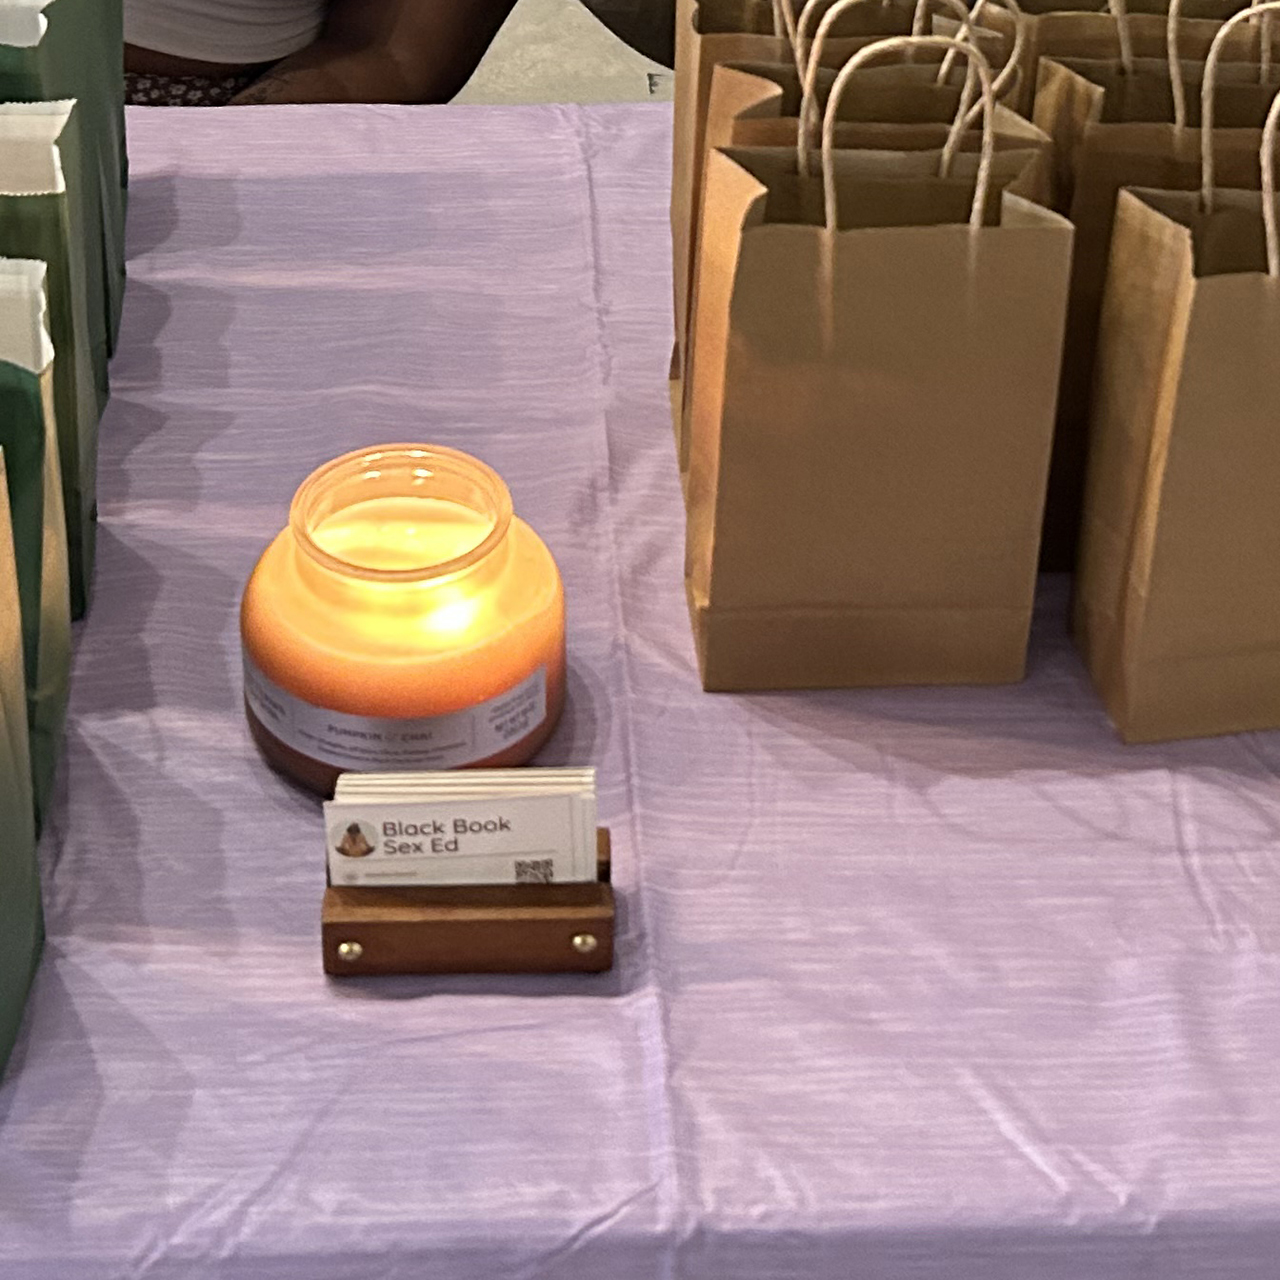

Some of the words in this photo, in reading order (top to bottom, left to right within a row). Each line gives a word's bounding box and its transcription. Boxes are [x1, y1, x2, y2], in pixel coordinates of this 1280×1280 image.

[383, 819, 446, 837] Black
[453, 817, 511, 834] Book
[384, 840, 423, 855] Sex
[431, 837, 458, 853] Ed
